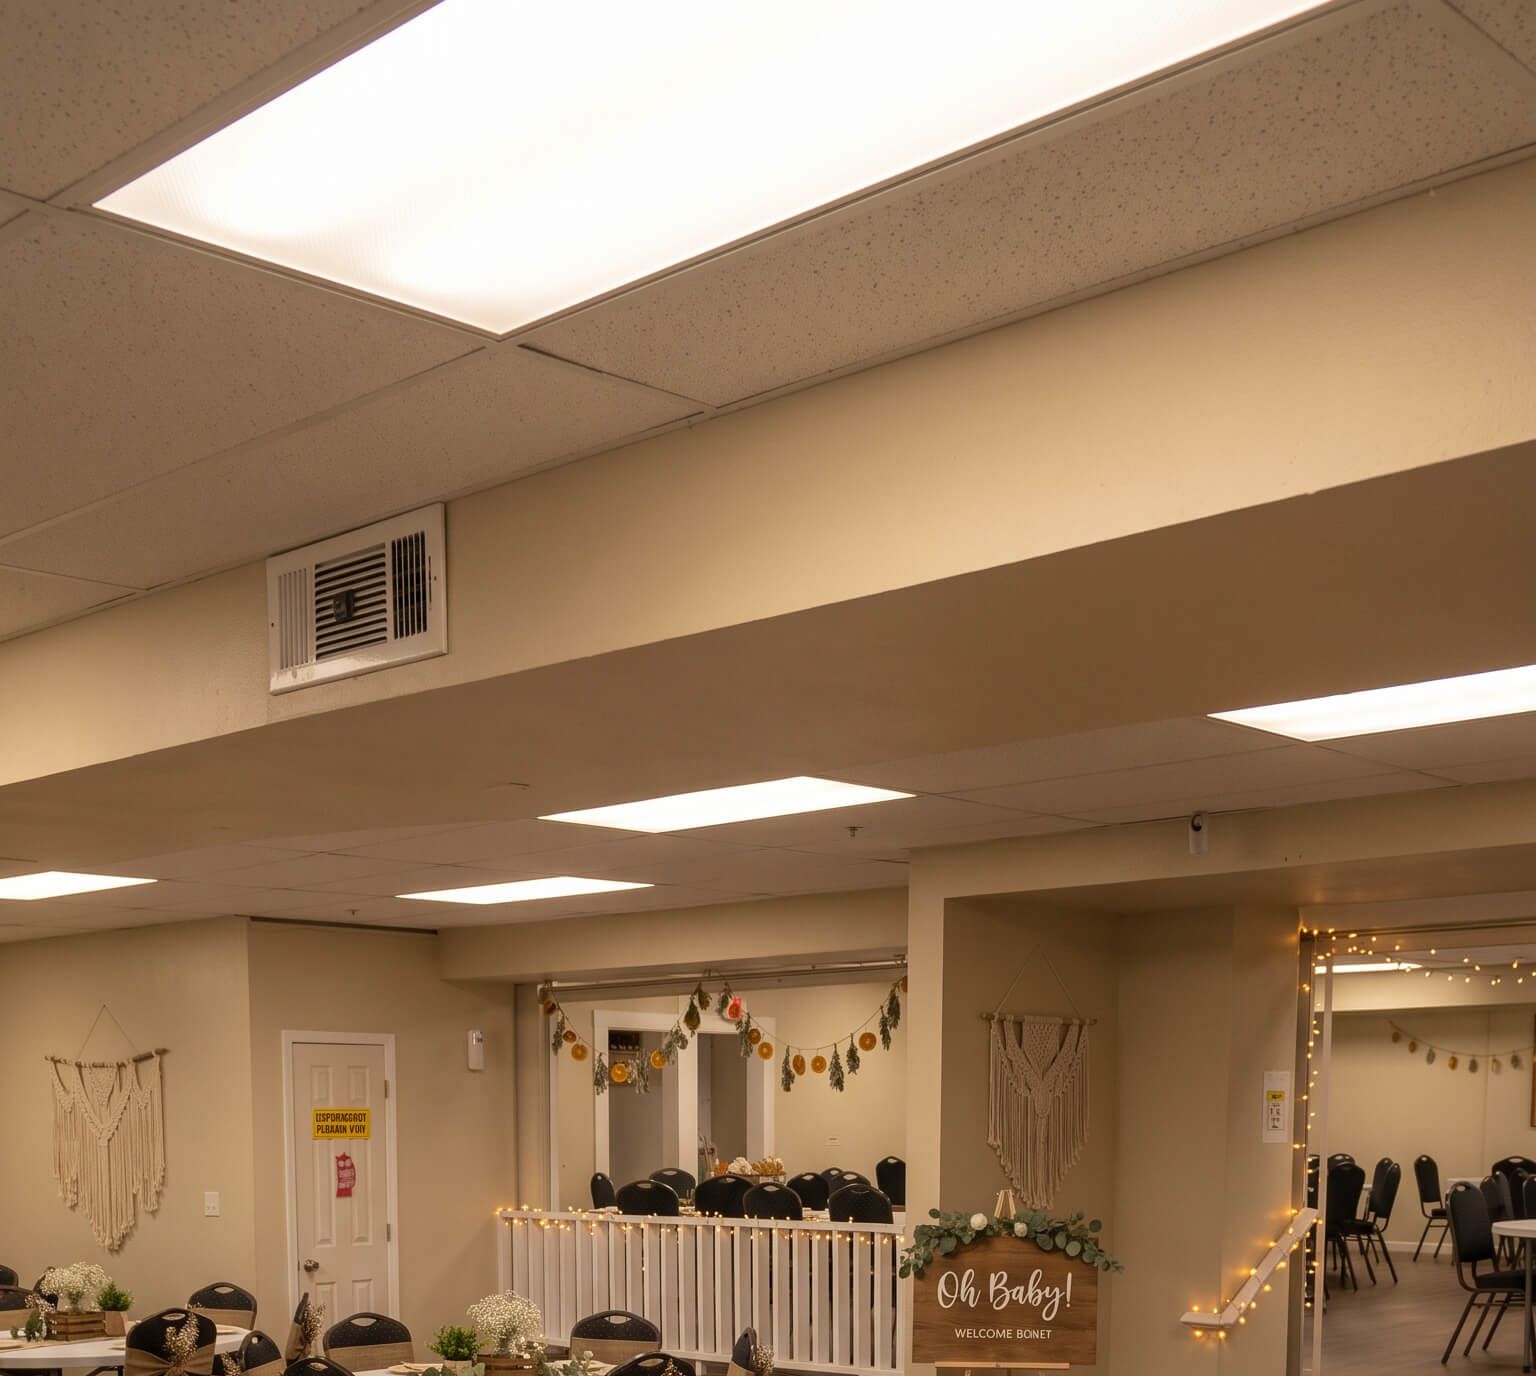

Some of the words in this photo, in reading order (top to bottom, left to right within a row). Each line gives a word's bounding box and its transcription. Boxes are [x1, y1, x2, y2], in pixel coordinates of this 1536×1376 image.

[937, 1268, 981, 1309] Oh
[989, 1268, 1072, 1321] Baby!
[954, 1328, 1012, 1339] WELCOME
